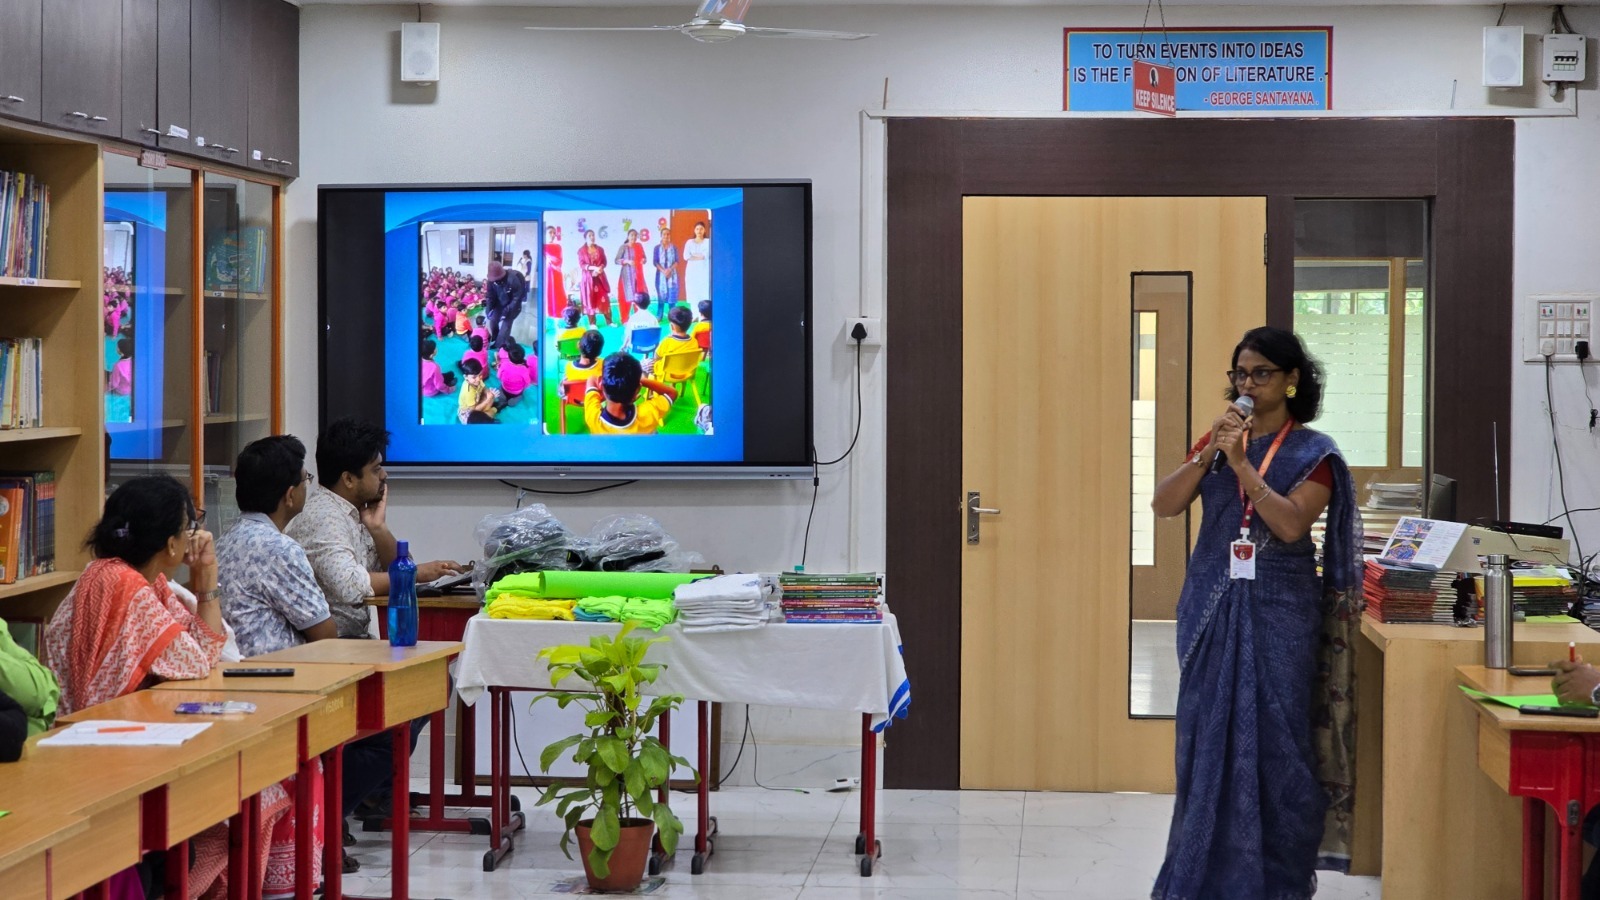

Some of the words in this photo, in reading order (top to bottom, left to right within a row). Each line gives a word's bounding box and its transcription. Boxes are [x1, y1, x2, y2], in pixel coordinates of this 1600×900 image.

[1093, 44, 1112, 58] TO
[1117, 43, 1156, 59] TURN
[1161, 43, 1217, 58] EVENTS
[1222, 43, 1256, 58] INTO
[1260, 42, 1304, 58] IDEAS
[1073, 67, 1087, 82] IS
[1091, 67, 1119, 82] THE
[1201, 67, 1221, 82] OF
[1225, 66, 1315, 82] LITERATURE
[1135, 88, 1151, 108] KEEP
[1151, 91, 1175, 112] SILENCE
[1210, 91, 1253, 105] GEORGE
[1256, 91, 1314, 105] SANTAYANA
[640, 228, 650, 242] 8
